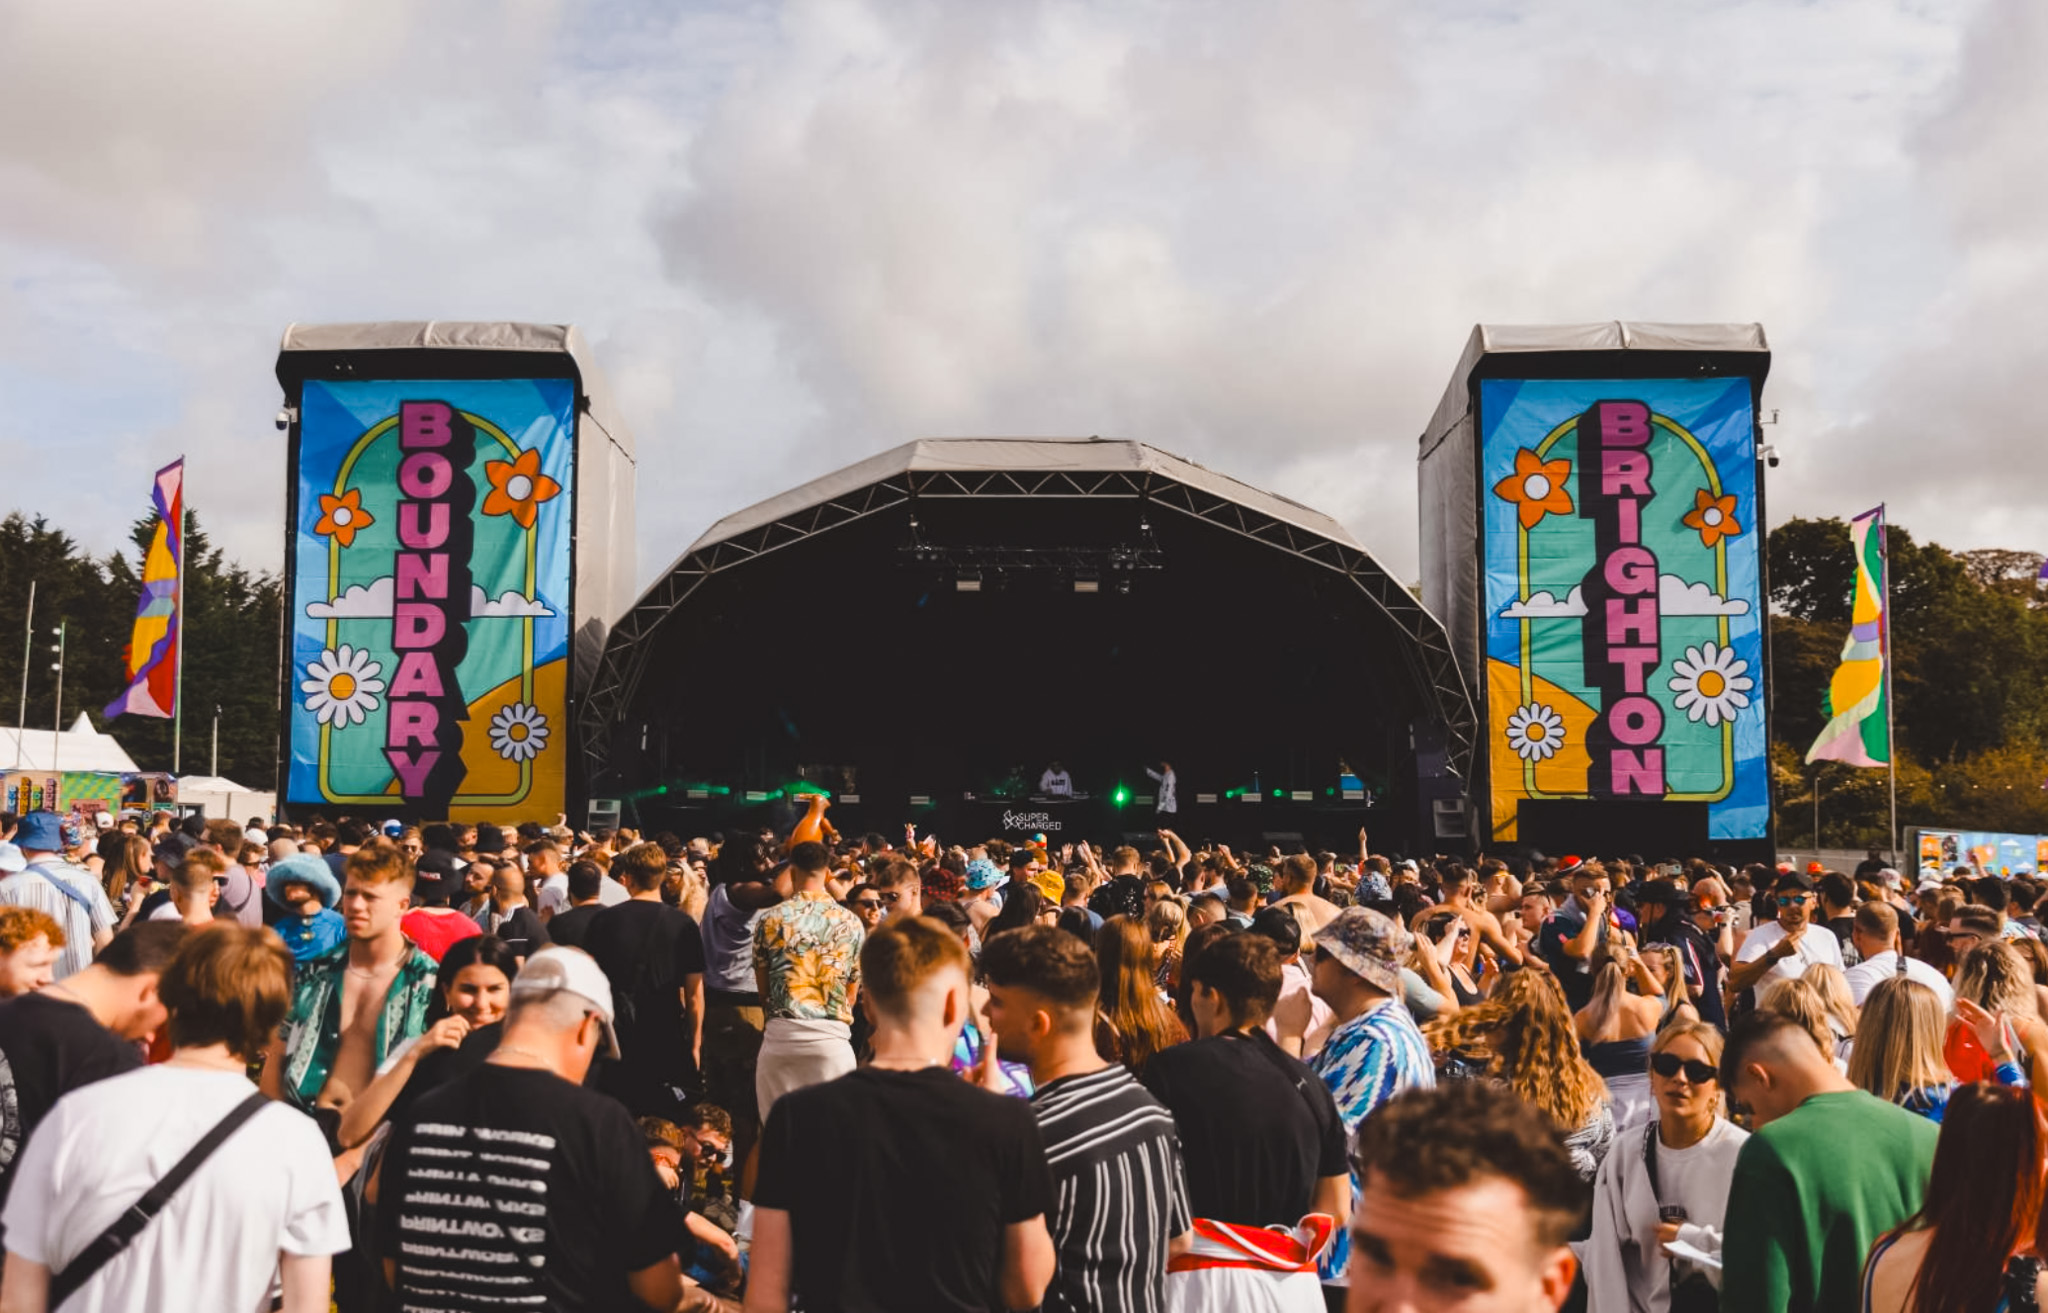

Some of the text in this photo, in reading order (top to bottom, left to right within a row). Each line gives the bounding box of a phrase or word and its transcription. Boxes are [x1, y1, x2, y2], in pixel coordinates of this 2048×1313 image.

[386, 401, 454, 798] BOUNDARY
[1598, 401, 1665, 796] BRIGHTON
[1018, 813, 1049, 822] SUPER
[1018, 822, 1062, 831] CHARGED
